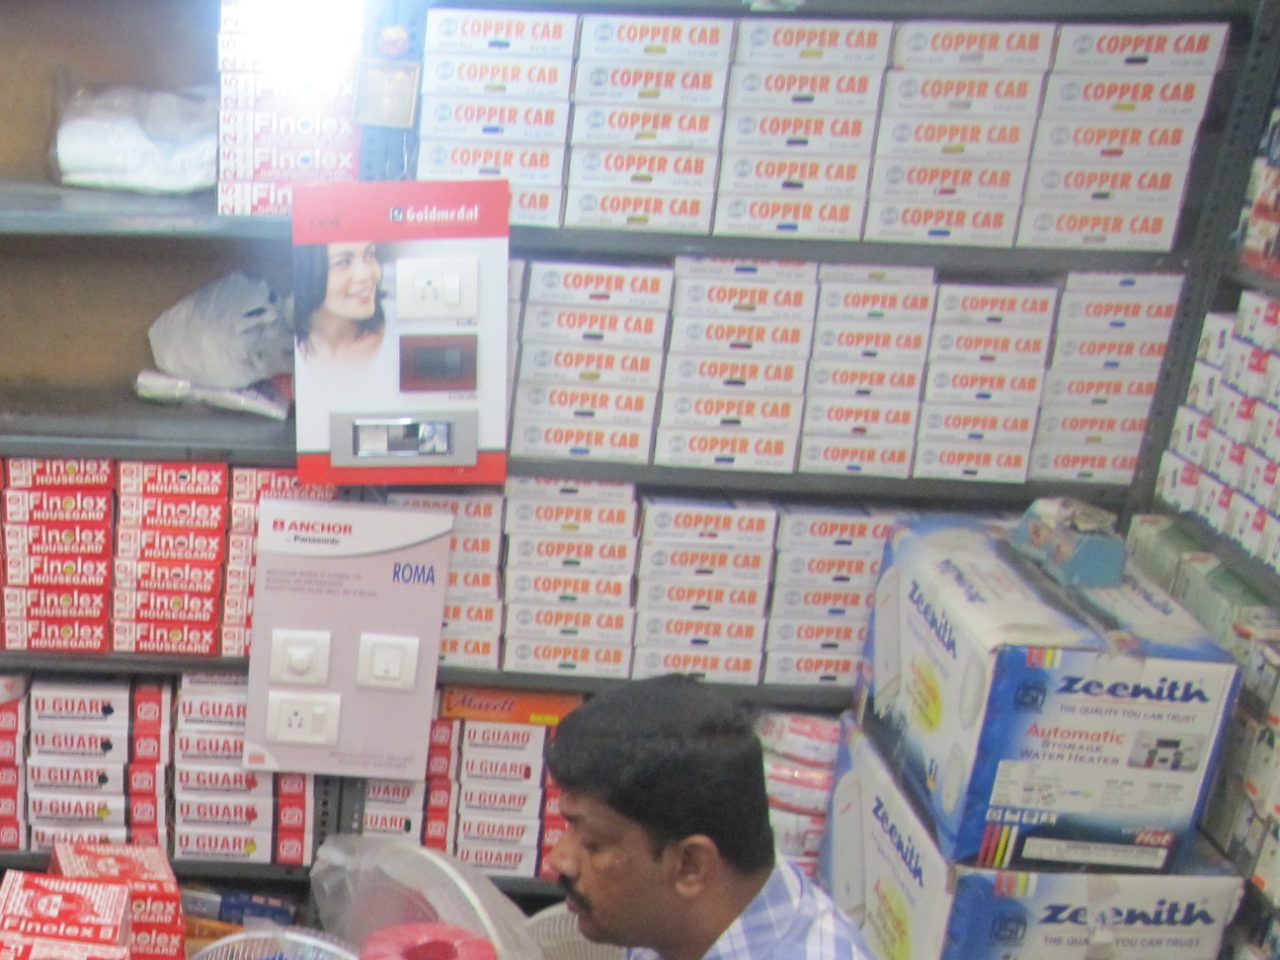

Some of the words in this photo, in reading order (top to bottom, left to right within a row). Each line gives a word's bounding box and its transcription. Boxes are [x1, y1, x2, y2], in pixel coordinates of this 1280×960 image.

[617, 25, 683, 45] COPPER
[690, 29, 721, 46] CAB
[773, 30, 840, 49] COPPER
[846, 33, 878, 50] CAB
[931, 35, 1001, 53] COPPER
[1007, 35, 1041, 53] CAB
[1097, 37, 1169, 56] COPPER
[1175, 37, 1210, 55] CAB
[460, 66, 522, 84] COPPER
[529, 68, 560, 86] CAB
[921, 82, 989, 100] COPPER
[996, 83, 1029, 101] CAB
[1084, 85, 1155, 103] COPPER
[1161, 85, 1196, 103] CAB
[760, 119, 825, 137] COPPER
[832, 122, 863, 139] CAB
[604, 155, 669, 175] COPPER
[675, 159, 706, 177] CAB
[405, 205, 479, 223] Goldmedal
[564, 274, 626, 294] COPPER
[630, 276, 661, 296] CAB
[1086, 305, 1142, 320] COPPER
[1149, 306, 1178, 322] CAB
[700, 364, 759, 381] COPPER
[766, 368, 795, 383] CAB
[833, 373, 887, 388] COPPER
[890, 375, 917, 390] CAB
[953, 377, 1007, 391] COPPER
[1011, 379, 1038, 393] CAB
[550, 393, 610, 410] COPPER
[617, 398, 645, 413] CAB
[143, 464, 222, 485] Finolex
[146, 483, 220, 495] HOUSEGARD
[29, 491, 107, 511] Finolex
[33, 509, 104, 521] HOUSEGARD
[536, 508, 593, 524] COPPER
[600, 512, 627, 526] CAB
[288, 520, 353, 536] ANCHOR
[675, 515, 733, 531] COPPER
[740, 520, 767, 534] CAB
[141, 530, 220, 551] Finolex
[144, 548, 216, 560] HOUSEGARD
[29, 556, 107, 576] Finolex
[392, 562, 436, 586] ROMA
[33, 574, 104, 585] HOUSEGARD
[136, 591, 214, 611] Finolex
[668, 590, 726, 604] COPPER
[730, 592, 758, 606] CAB
[139, 609, 211, 622] HOUSEGARD
[536, 613, 593, 629] COPPER
[597, 615, 625, 631] CAB
[27, 620, 103, 640] Finolex
[31, 638, 101, 649] HOUSEGARD
[200, 702, 247, 718] GUAR
[1166, 712, 1197, 723] TRUST
[482, 728, 530, 744] GUARD
[1026, 723, 1126, 744] Automatic
[479, 791, 528, 807] GUARD
[477, 822, 525, 838] GUARD
[475, 850, 523, 865] GUARD
[131, 896, 177, 914] olex
[1, 916, 95, 938] Finolex
[1140, 938, 1163, 947] CAN
[1167, 939, 1200, 948] TRUST
